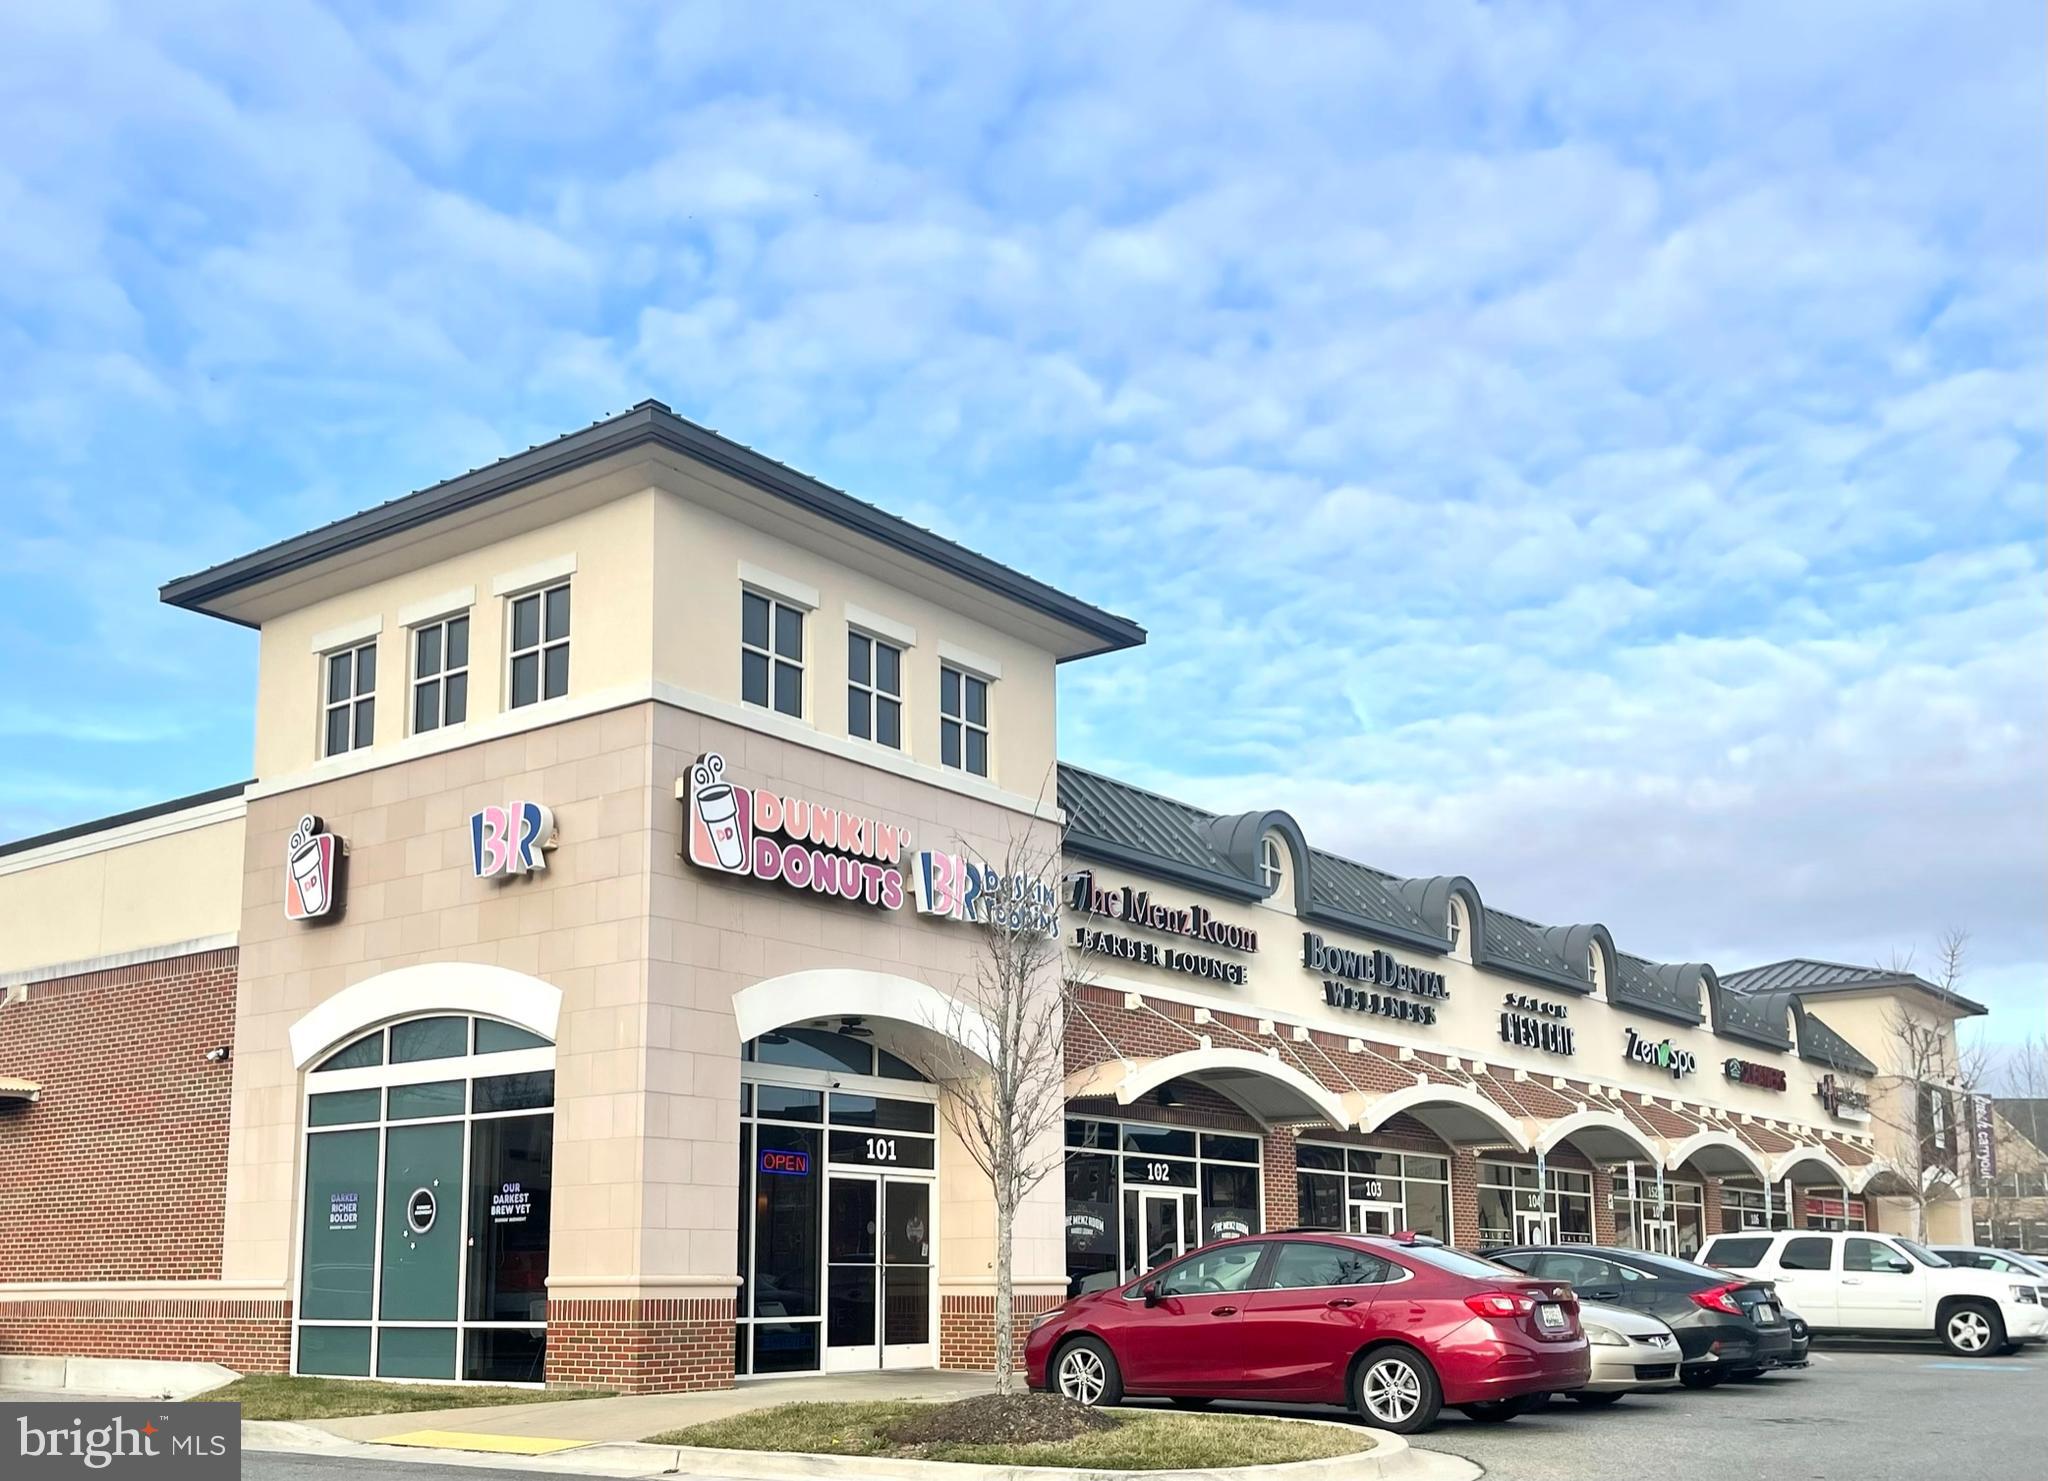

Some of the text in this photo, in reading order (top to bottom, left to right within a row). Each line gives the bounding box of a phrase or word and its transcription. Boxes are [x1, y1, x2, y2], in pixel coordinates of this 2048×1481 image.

[470, 800, 550, 878] BR
[753, 788, 911, 863] DUNKIN'
[753, 837, 903, 910] DONUTS
[914, 850, 982, 922] BR
[1063, 869, 1260, 953] The Menz Room
[1077, 928, 1249, 986] BARBER LOUNGE
[1304, 932, 1451, 1000] BOWIE DENTAL
[1324, 981, 1438, 1025] WELLNESS
[1506, 993, 1568, 1018] SALON
[1543, 1023, 1576, 1057] CHIC
[1625, 1027, 1661, 1066] Zen
[1665, 1039, 1697, 1079] Spa
[763, 1153, 806, 1172] OPEN
[866, 1138, 897, 1161] 101
[1976, 1131, 1995, 1180] carryout
[1147, 1163, 1170, 1182] 102
[493, 1193, 529, 1205] DARKEST
[503, 1183, 520, 1193] OUR
[1365, 1181, 1382, 1197] 103
[330, 1213, 358, 1223] BOLDER
[331, 1203, 357, 1213] RICHER
[491, 1203, 531, 1216] BREW YET
[1652, 1206, 1660, 1218] 10
